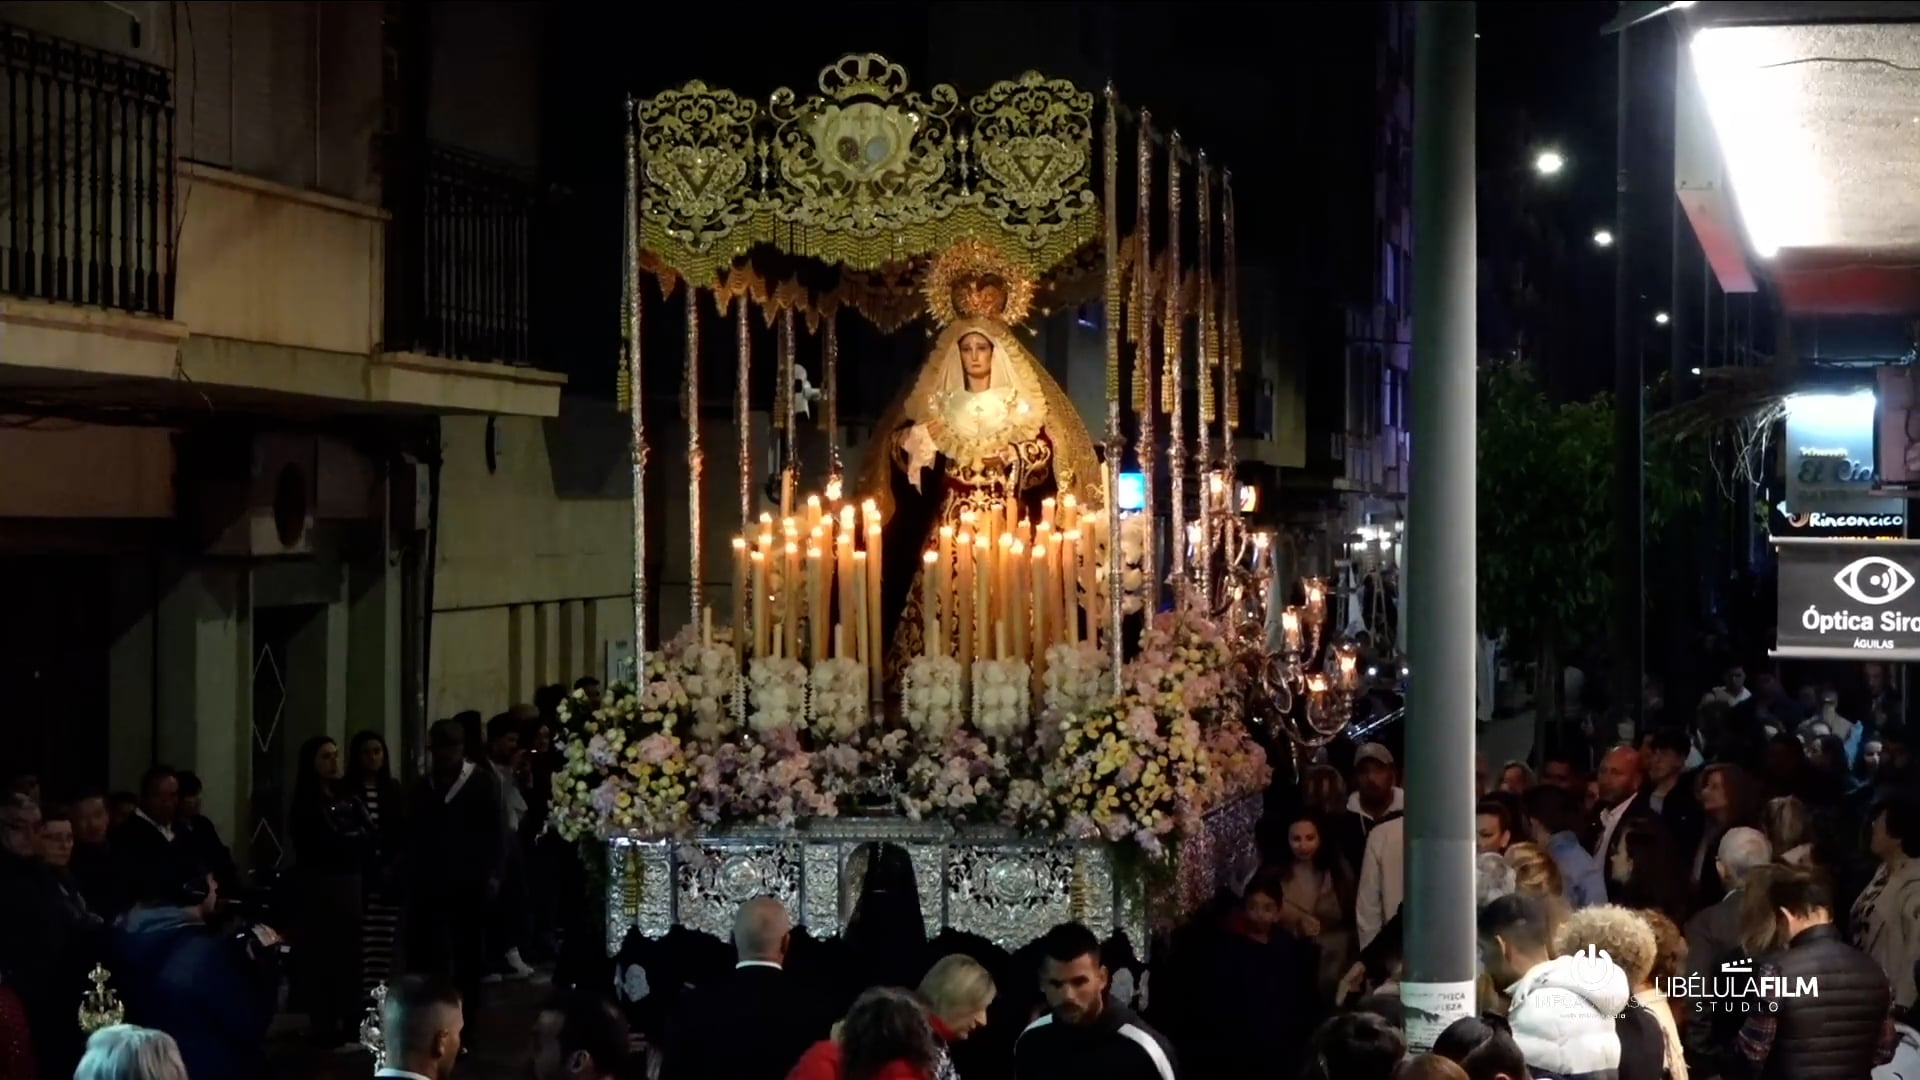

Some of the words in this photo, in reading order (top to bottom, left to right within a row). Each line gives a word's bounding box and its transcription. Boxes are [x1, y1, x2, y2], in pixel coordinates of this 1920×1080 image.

[1808, 512, 1903, 528] Rinconcico
[1802, 604, 1874, 634] Óptica
[1853, 637, 1895, 649] ÁGUILAS
